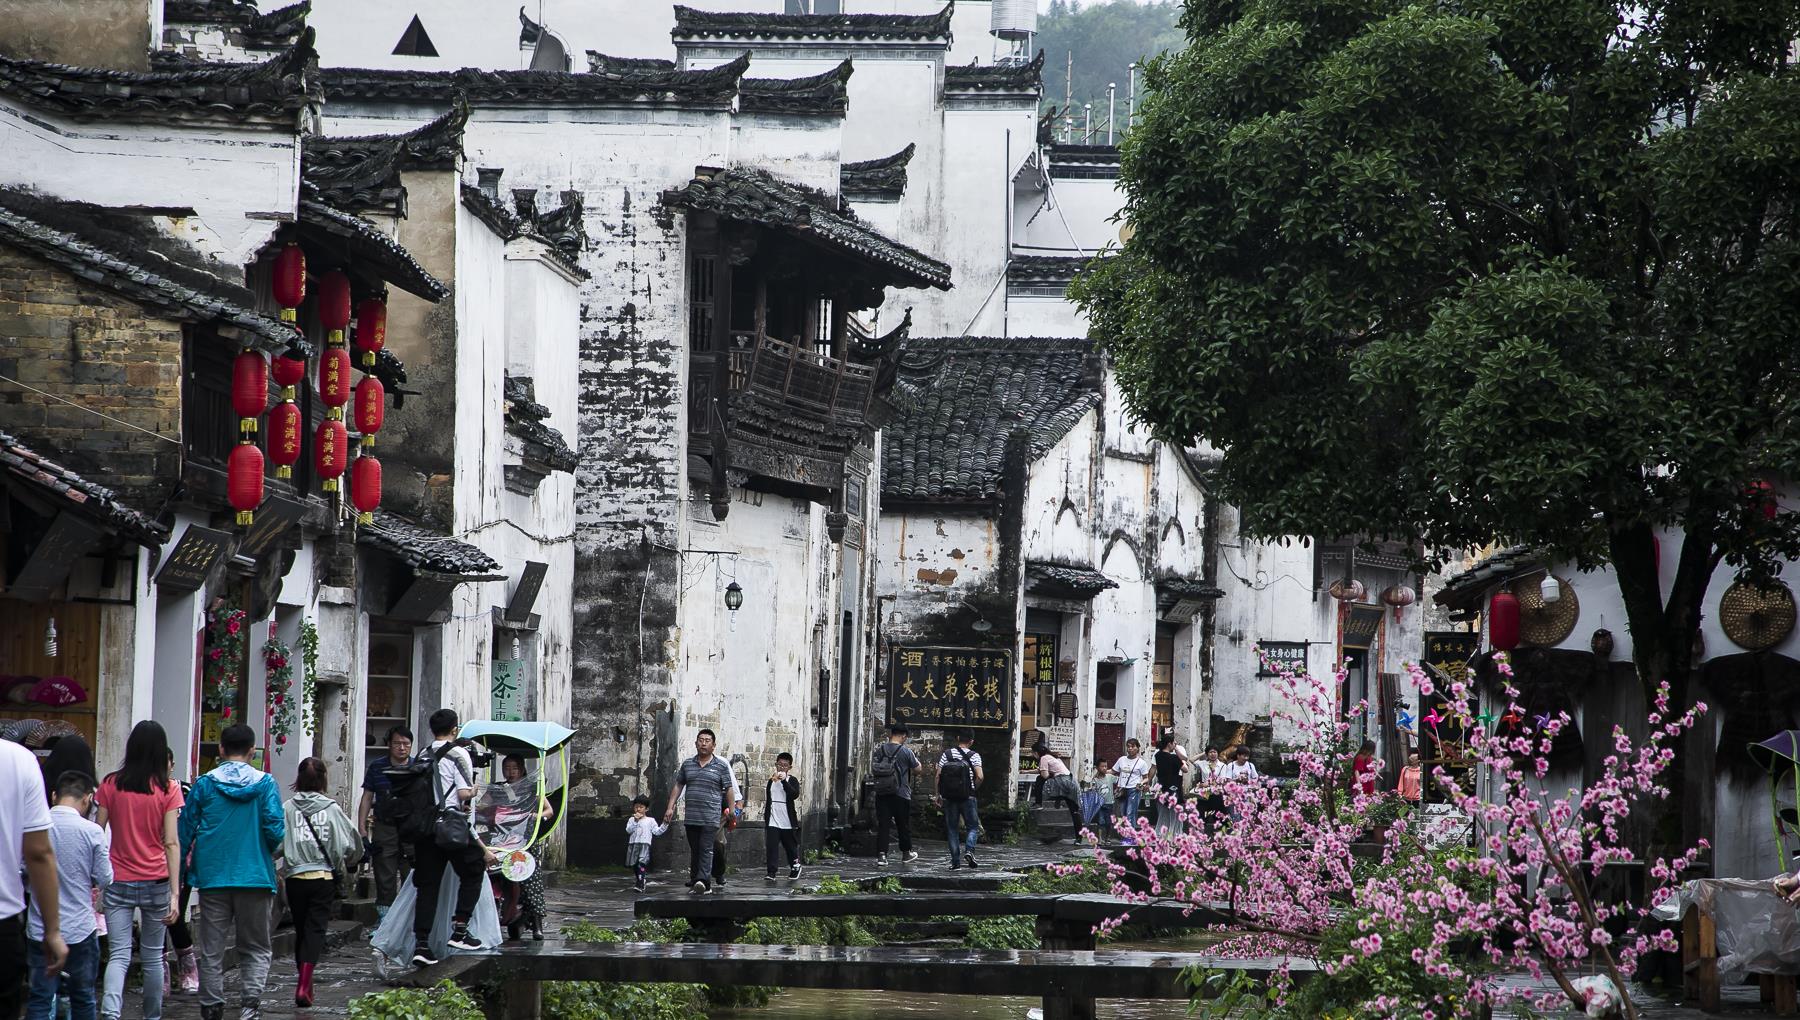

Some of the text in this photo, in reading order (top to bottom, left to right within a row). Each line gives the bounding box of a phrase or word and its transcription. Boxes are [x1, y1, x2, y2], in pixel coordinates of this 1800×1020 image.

[491, 662, 518, 721] 新茶上市
[295, 809, 328, 827] DAD
